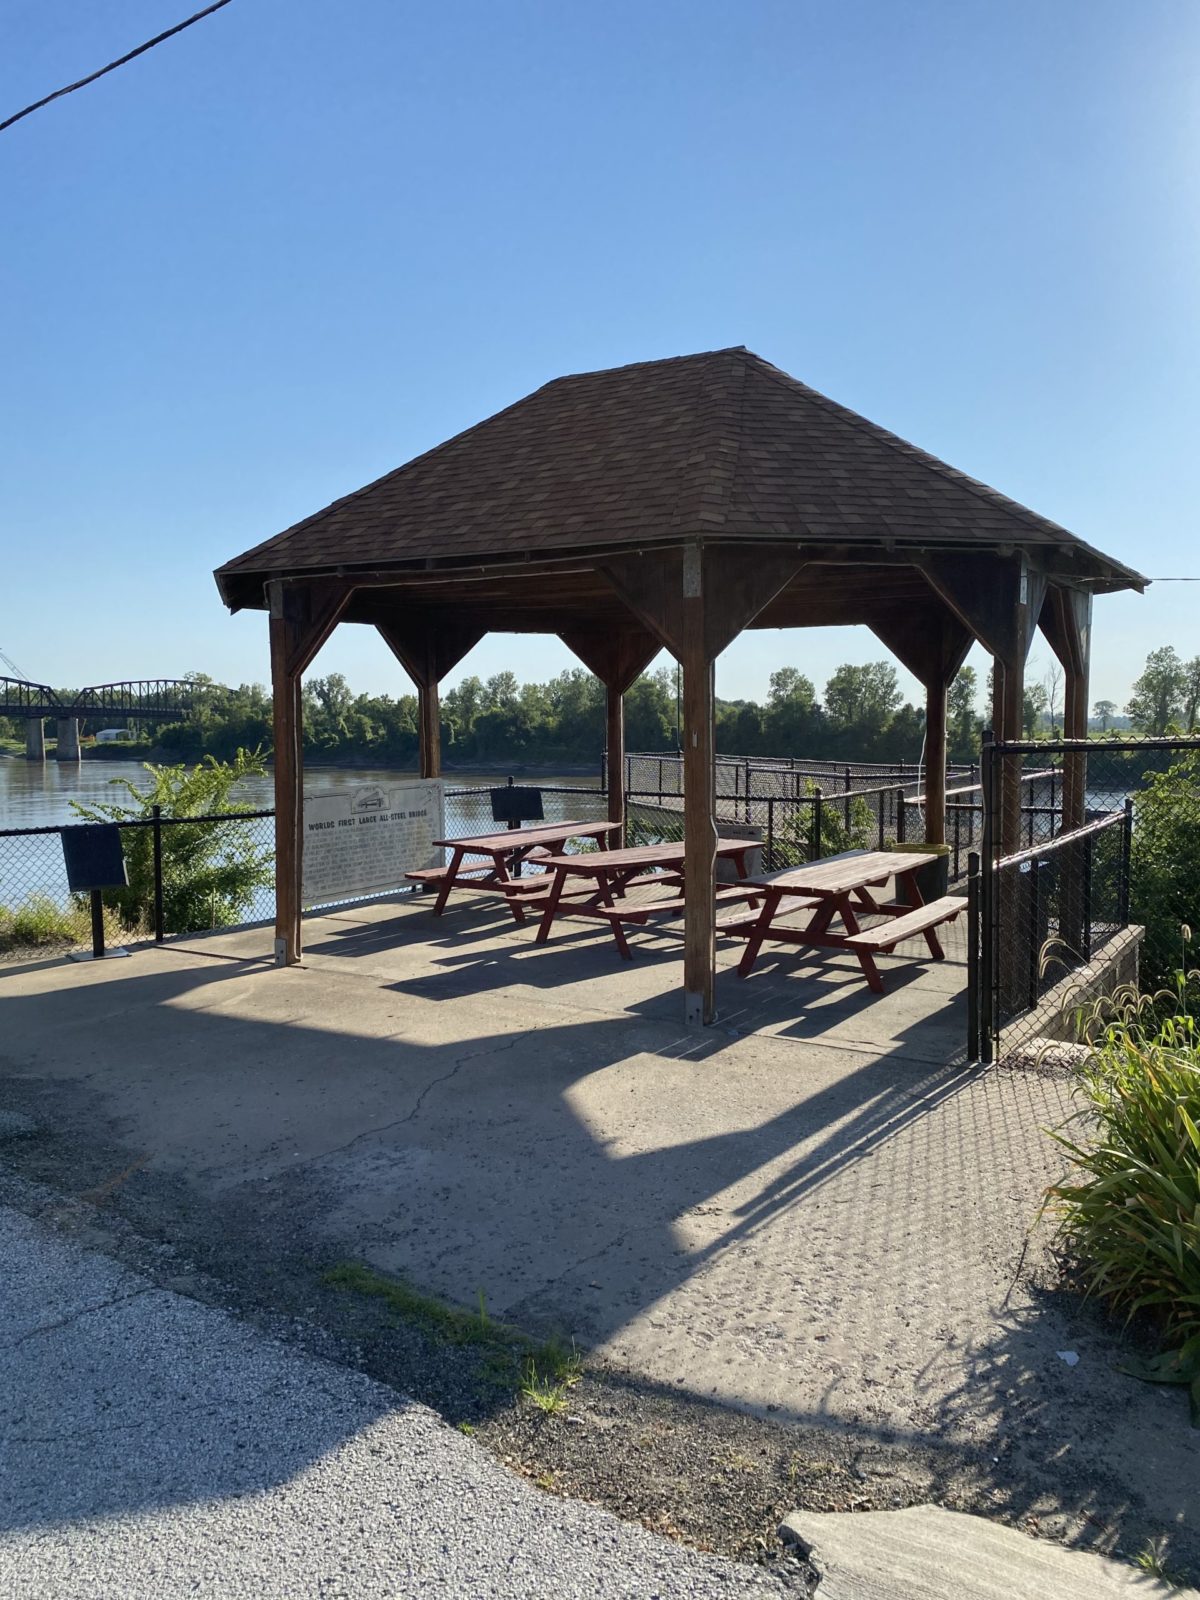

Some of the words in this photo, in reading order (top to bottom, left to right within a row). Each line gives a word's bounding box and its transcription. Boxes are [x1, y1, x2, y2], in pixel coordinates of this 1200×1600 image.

[338, 818, 356, 827] FIRST
[380, 811, 407, 822] ALL-STEEL
[408, 809, 428, 818] BRIDGE
